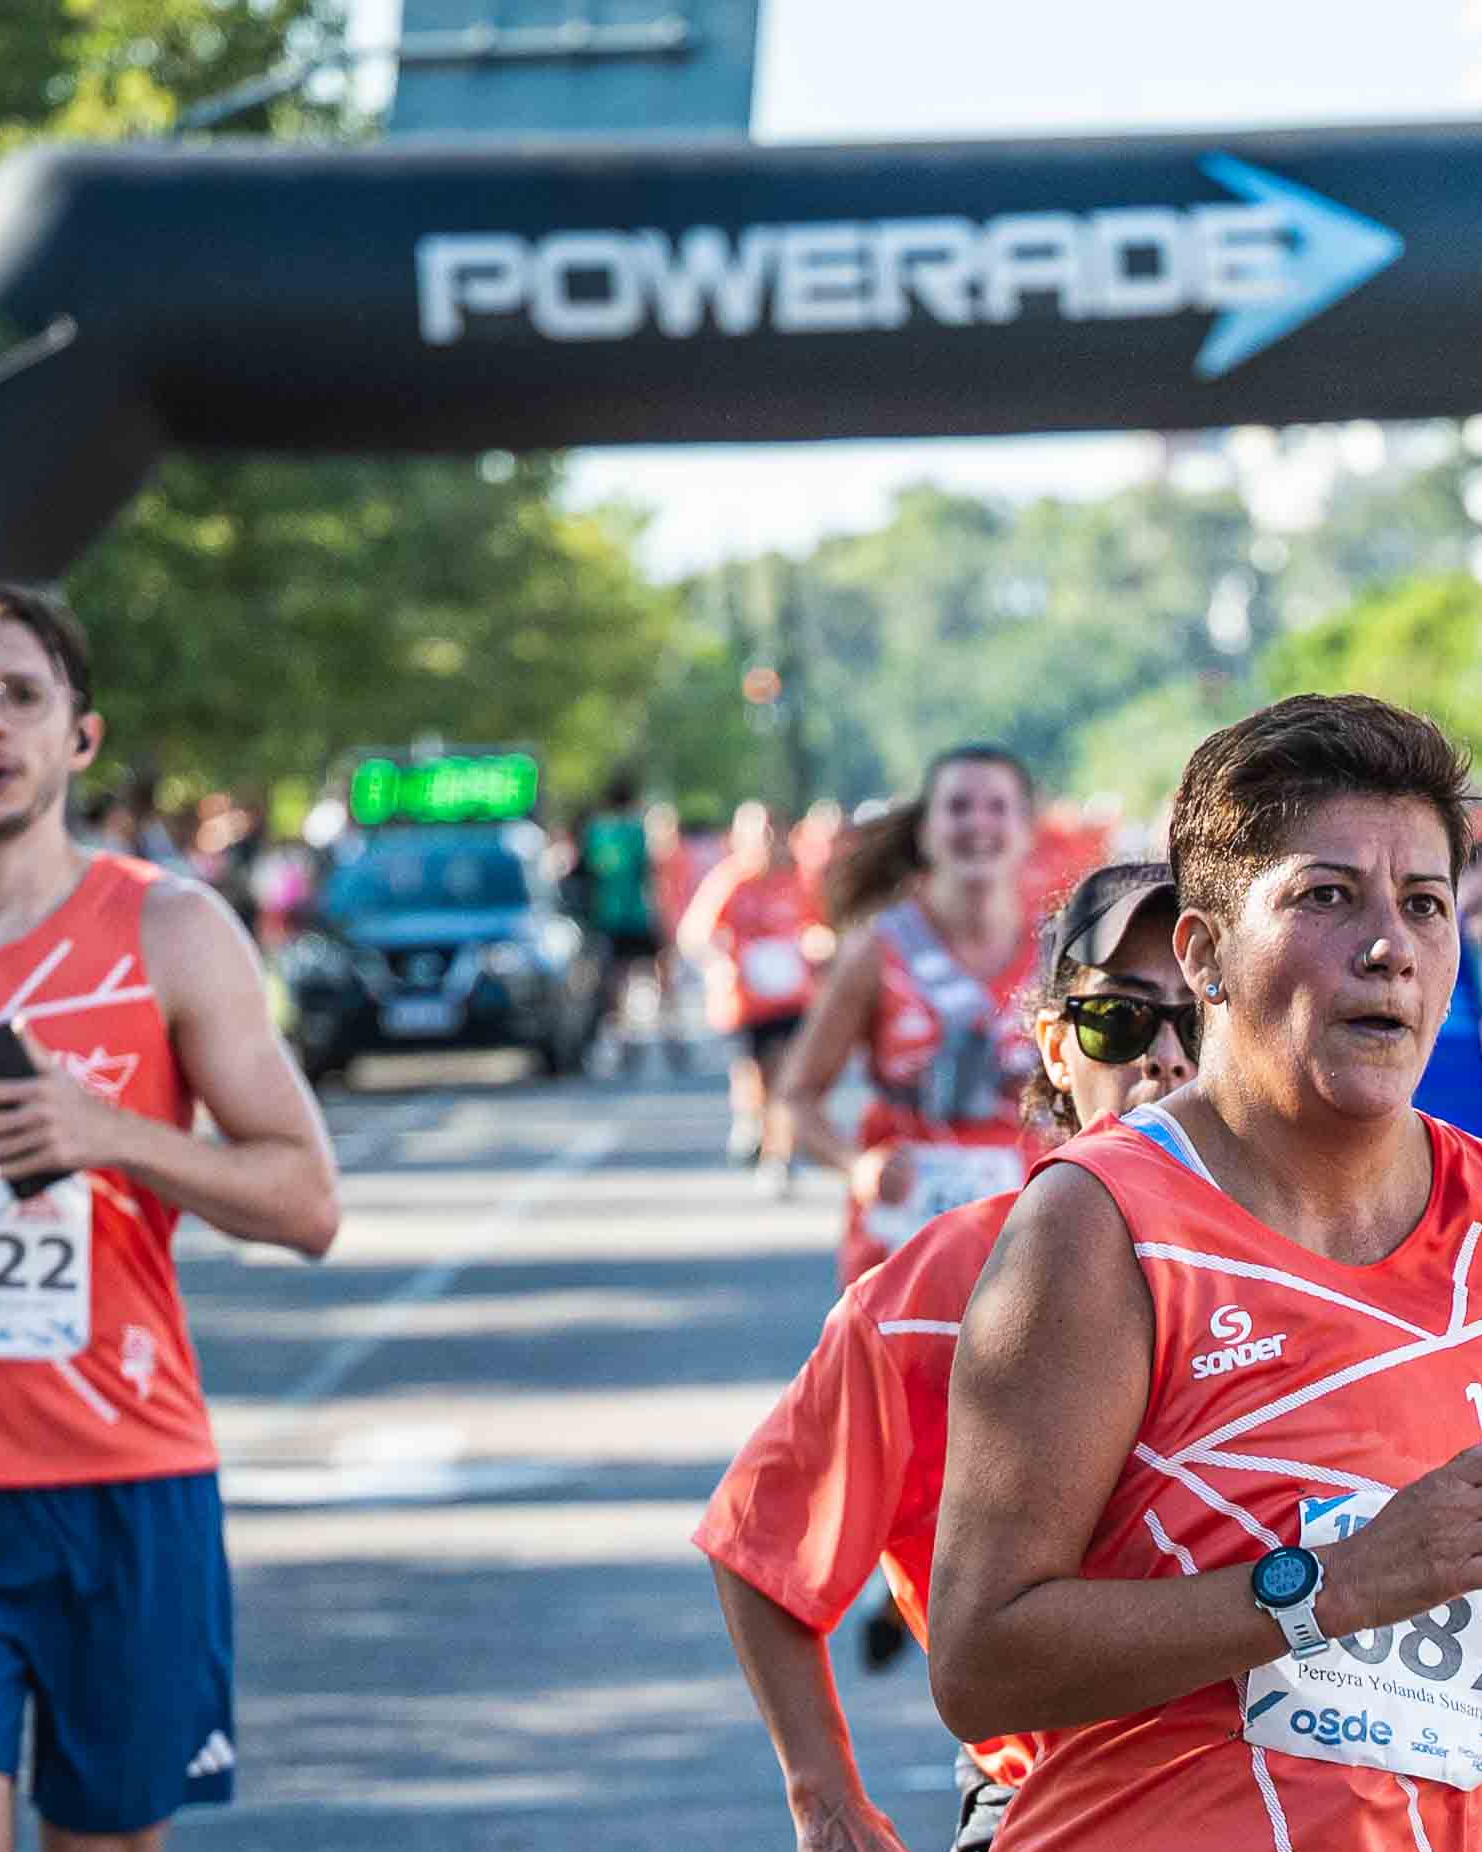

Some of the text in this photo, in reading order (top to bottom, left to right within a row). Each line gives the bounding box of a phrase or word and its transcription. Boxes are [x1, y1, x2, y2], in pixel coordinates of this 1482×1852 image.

[415, 203, 1302, 345] POWERADE
[1297, 1662, 1364, 1690] Pereyra
[1368, 1675, 1436, 1706] Yolanda
[1289, 1707, 1394, 1746] osde
